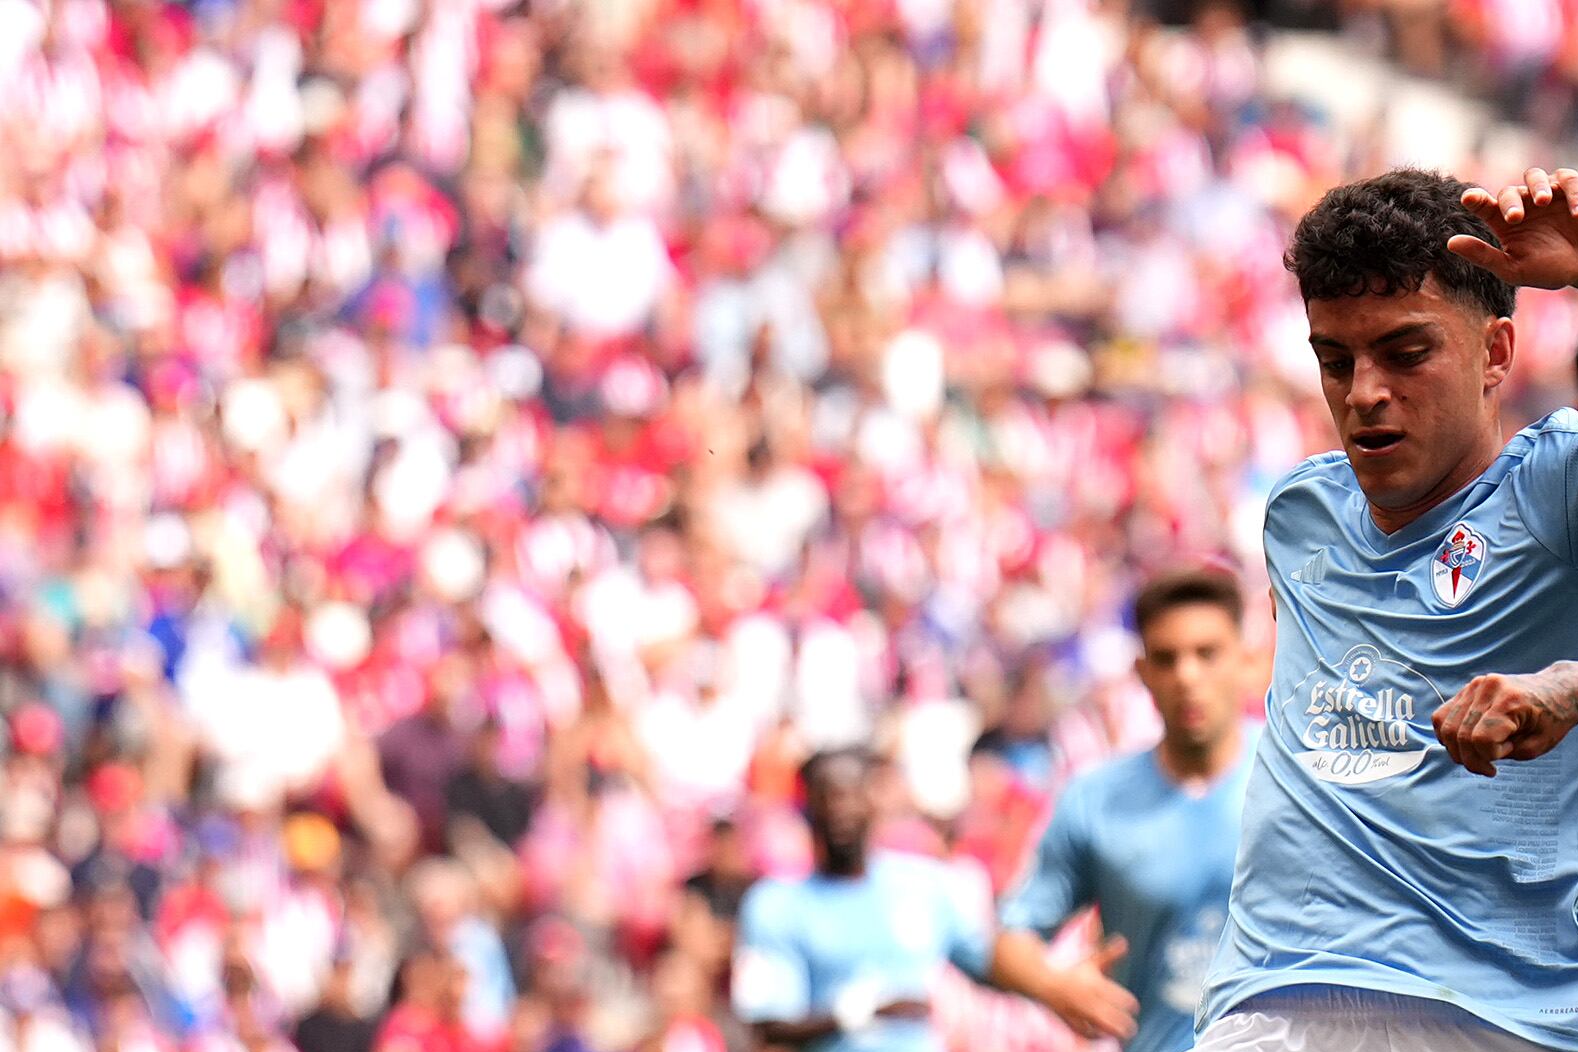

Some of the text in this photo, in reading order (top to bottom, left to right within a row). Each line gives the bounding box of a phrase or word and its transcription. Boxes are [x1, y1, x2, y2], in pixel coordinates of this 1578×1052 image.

[1304, 675, 1416, 722] Estrella
[1302, 714, 1409, 750] Galicia
[1331, 750, 1372, 777] 0,0
